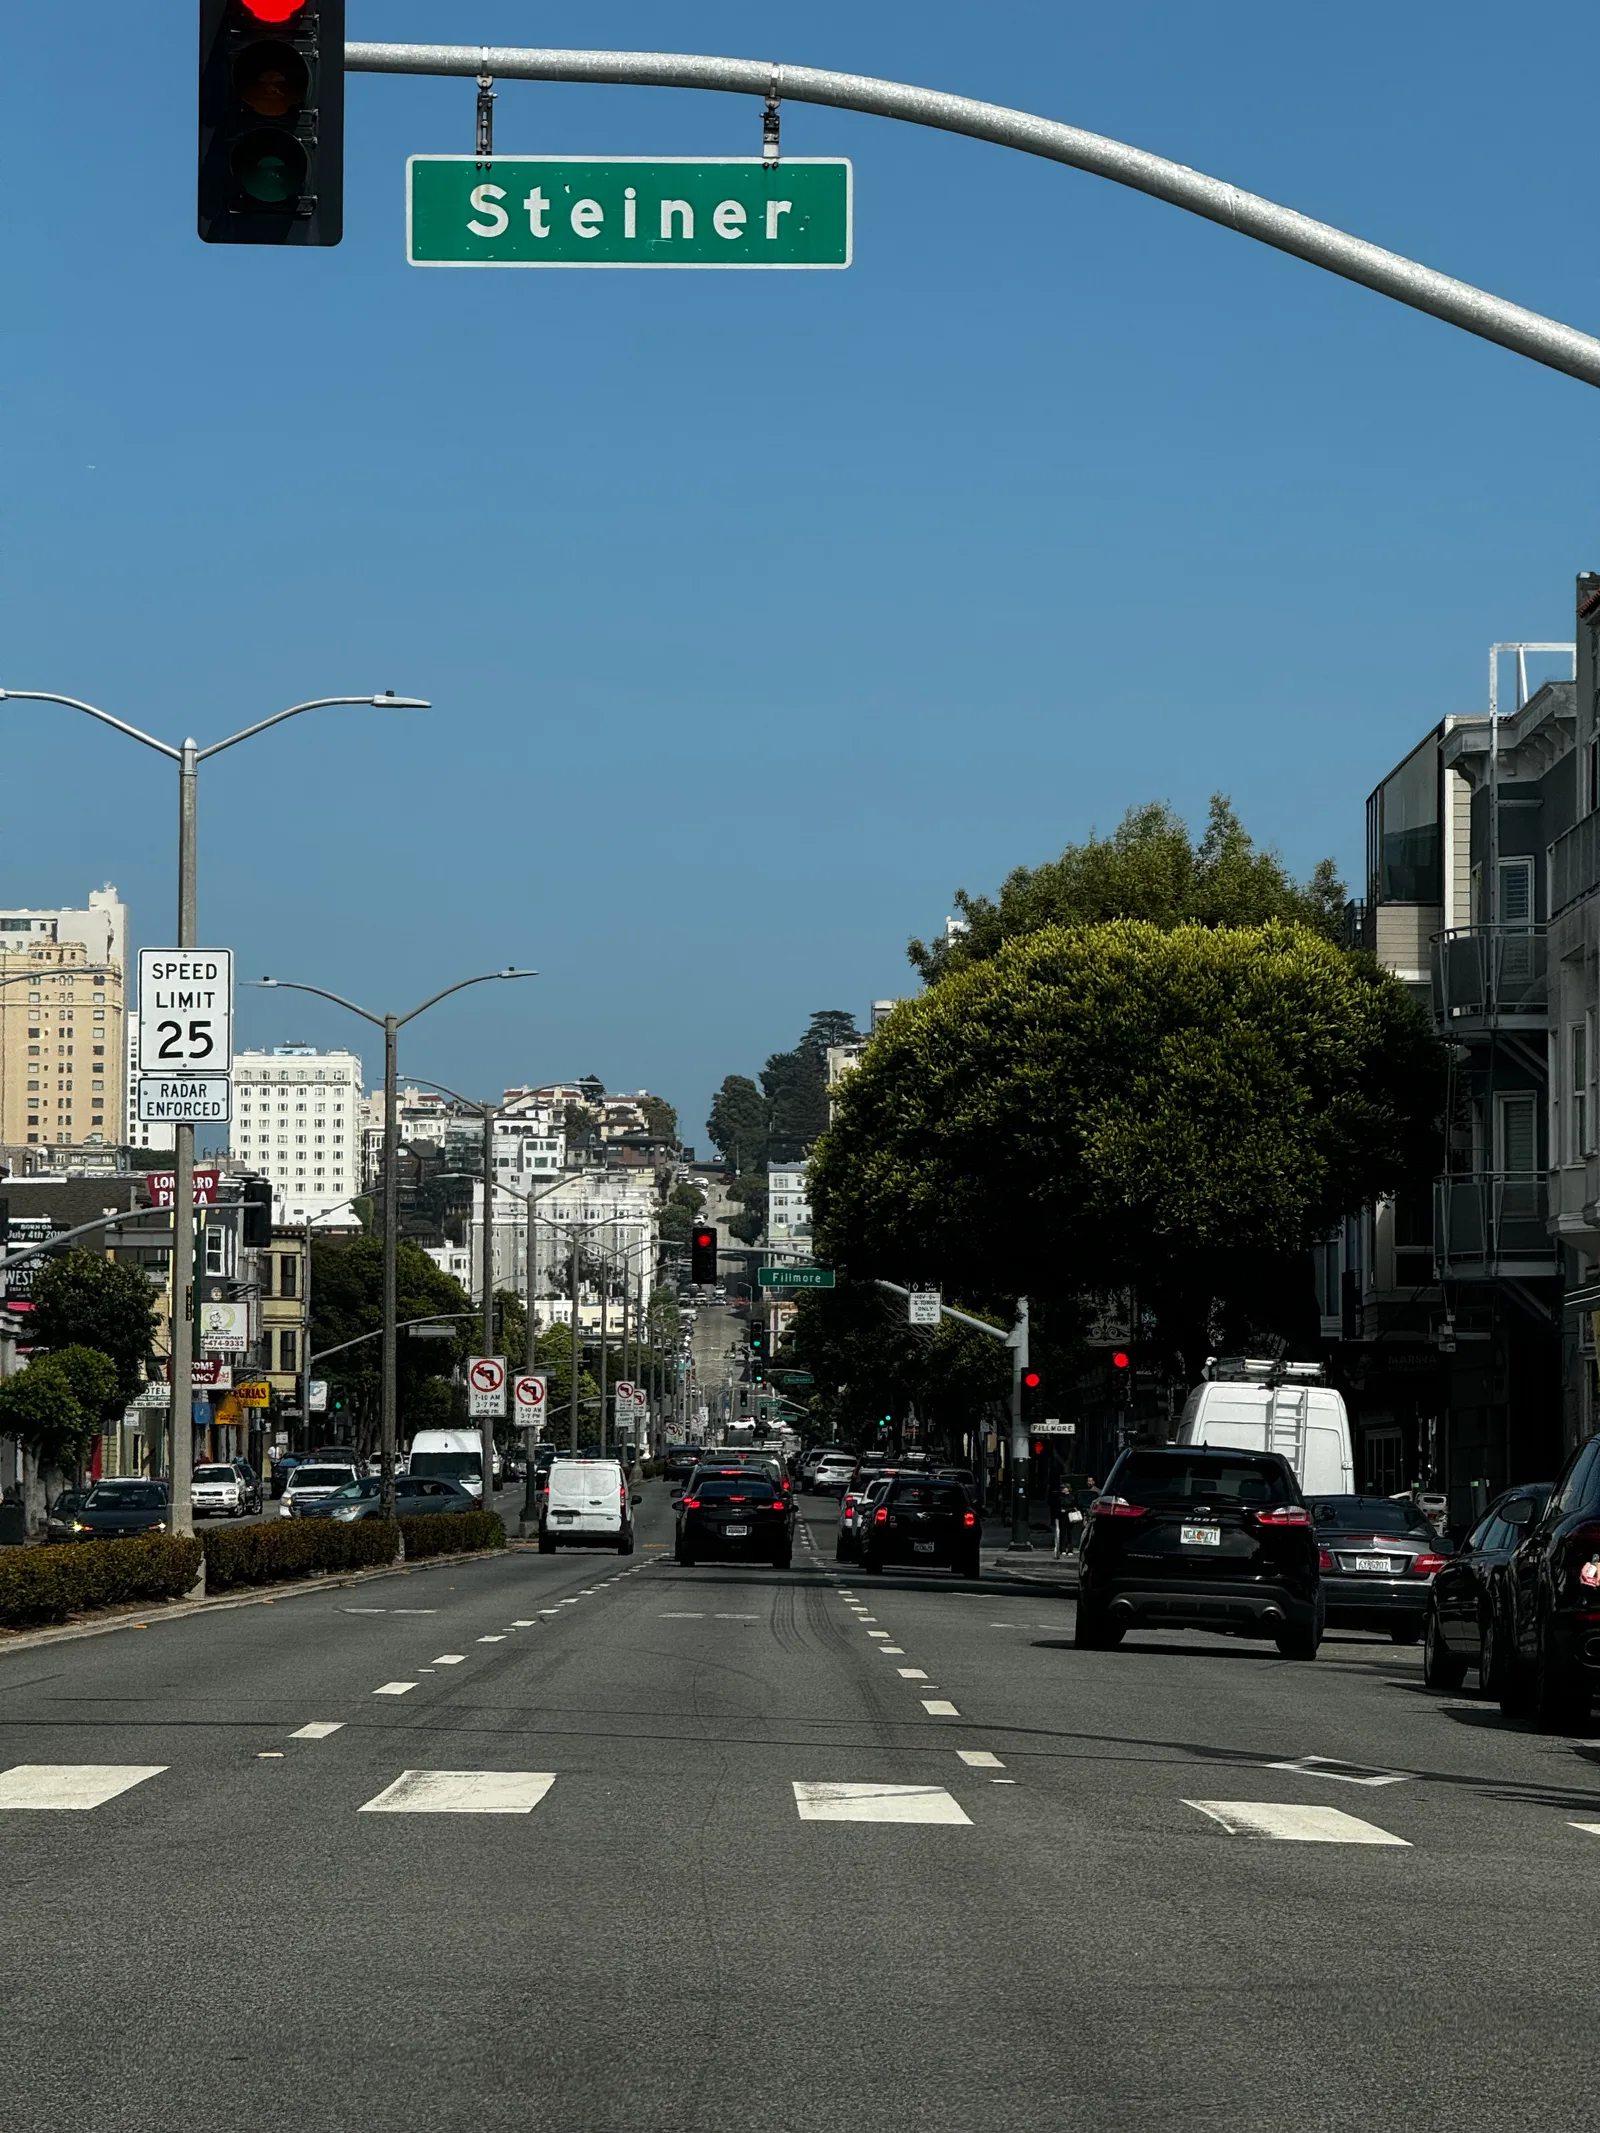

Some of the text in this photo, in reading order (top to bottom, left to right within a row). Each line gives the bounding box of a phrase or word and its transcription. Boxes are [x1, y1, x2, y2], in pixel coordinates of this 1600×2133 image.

[466, 183, 793, 239] Steiner
[152, 963, 218, 980] SPEED
[156, 992, 215, 1008] LIMIT
[157, 1020, 214, 1059] 25
[161, 1084, 207, 1098] RADAR
[147, 1102, 221, 1117] ENFORCED
[154, 1176, 213, 1189] LORD
[159, 1190, 208, 1206] PLZA
[7, 1229, 26, 1240] July
[28, 1230, 44, 1239] 4th
[772, 1272, 822, 1283] Fillmore
[190, 1361, 214, 1371] COME
[1388, 1354, 1437, 1365] MARINA
[191, 1373, 215, 1382] ANCY
